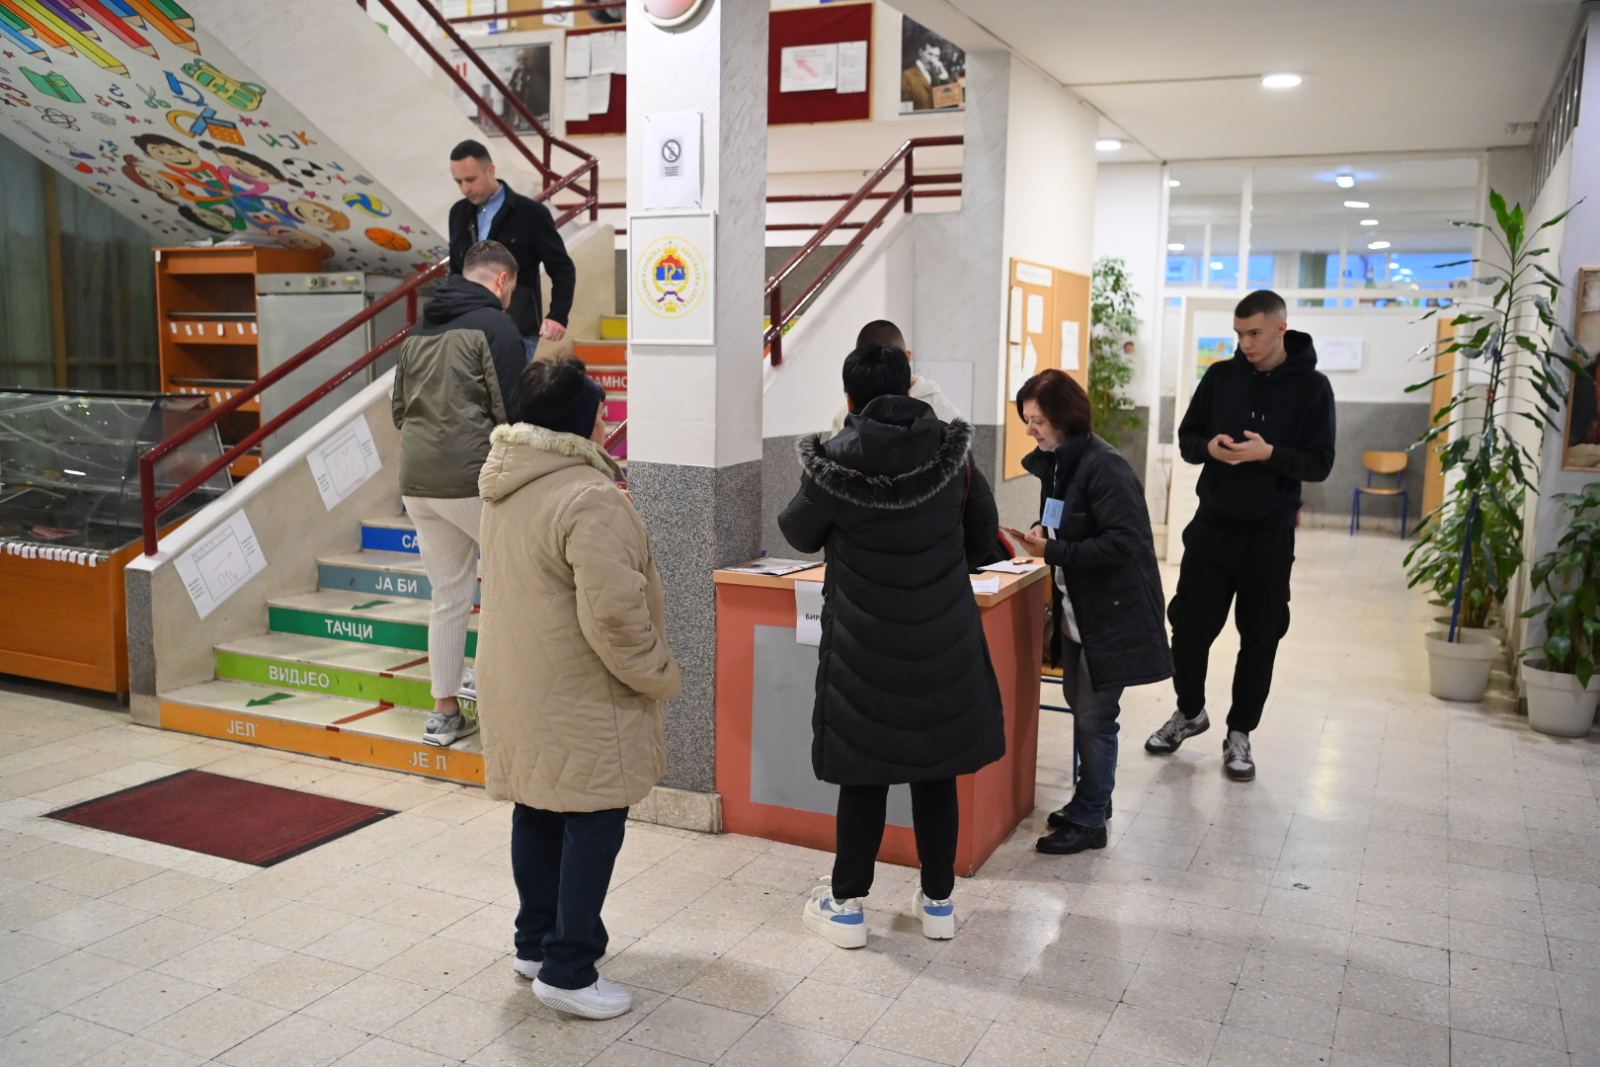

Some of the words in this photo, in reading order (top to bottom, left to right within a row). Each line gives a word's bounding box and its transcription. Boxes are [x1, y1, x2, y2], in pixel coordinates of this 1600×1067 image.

[402, 534, 417, 549] СА
[375, 576, 393, 592] ЈА
[397, 578, 418, 595] БИ
[805, 612, 821, 621] БИР
[324, 619, 373, 641] ТАЧЦИ
[269, 665, 330, 688] ВИДЈЕО
